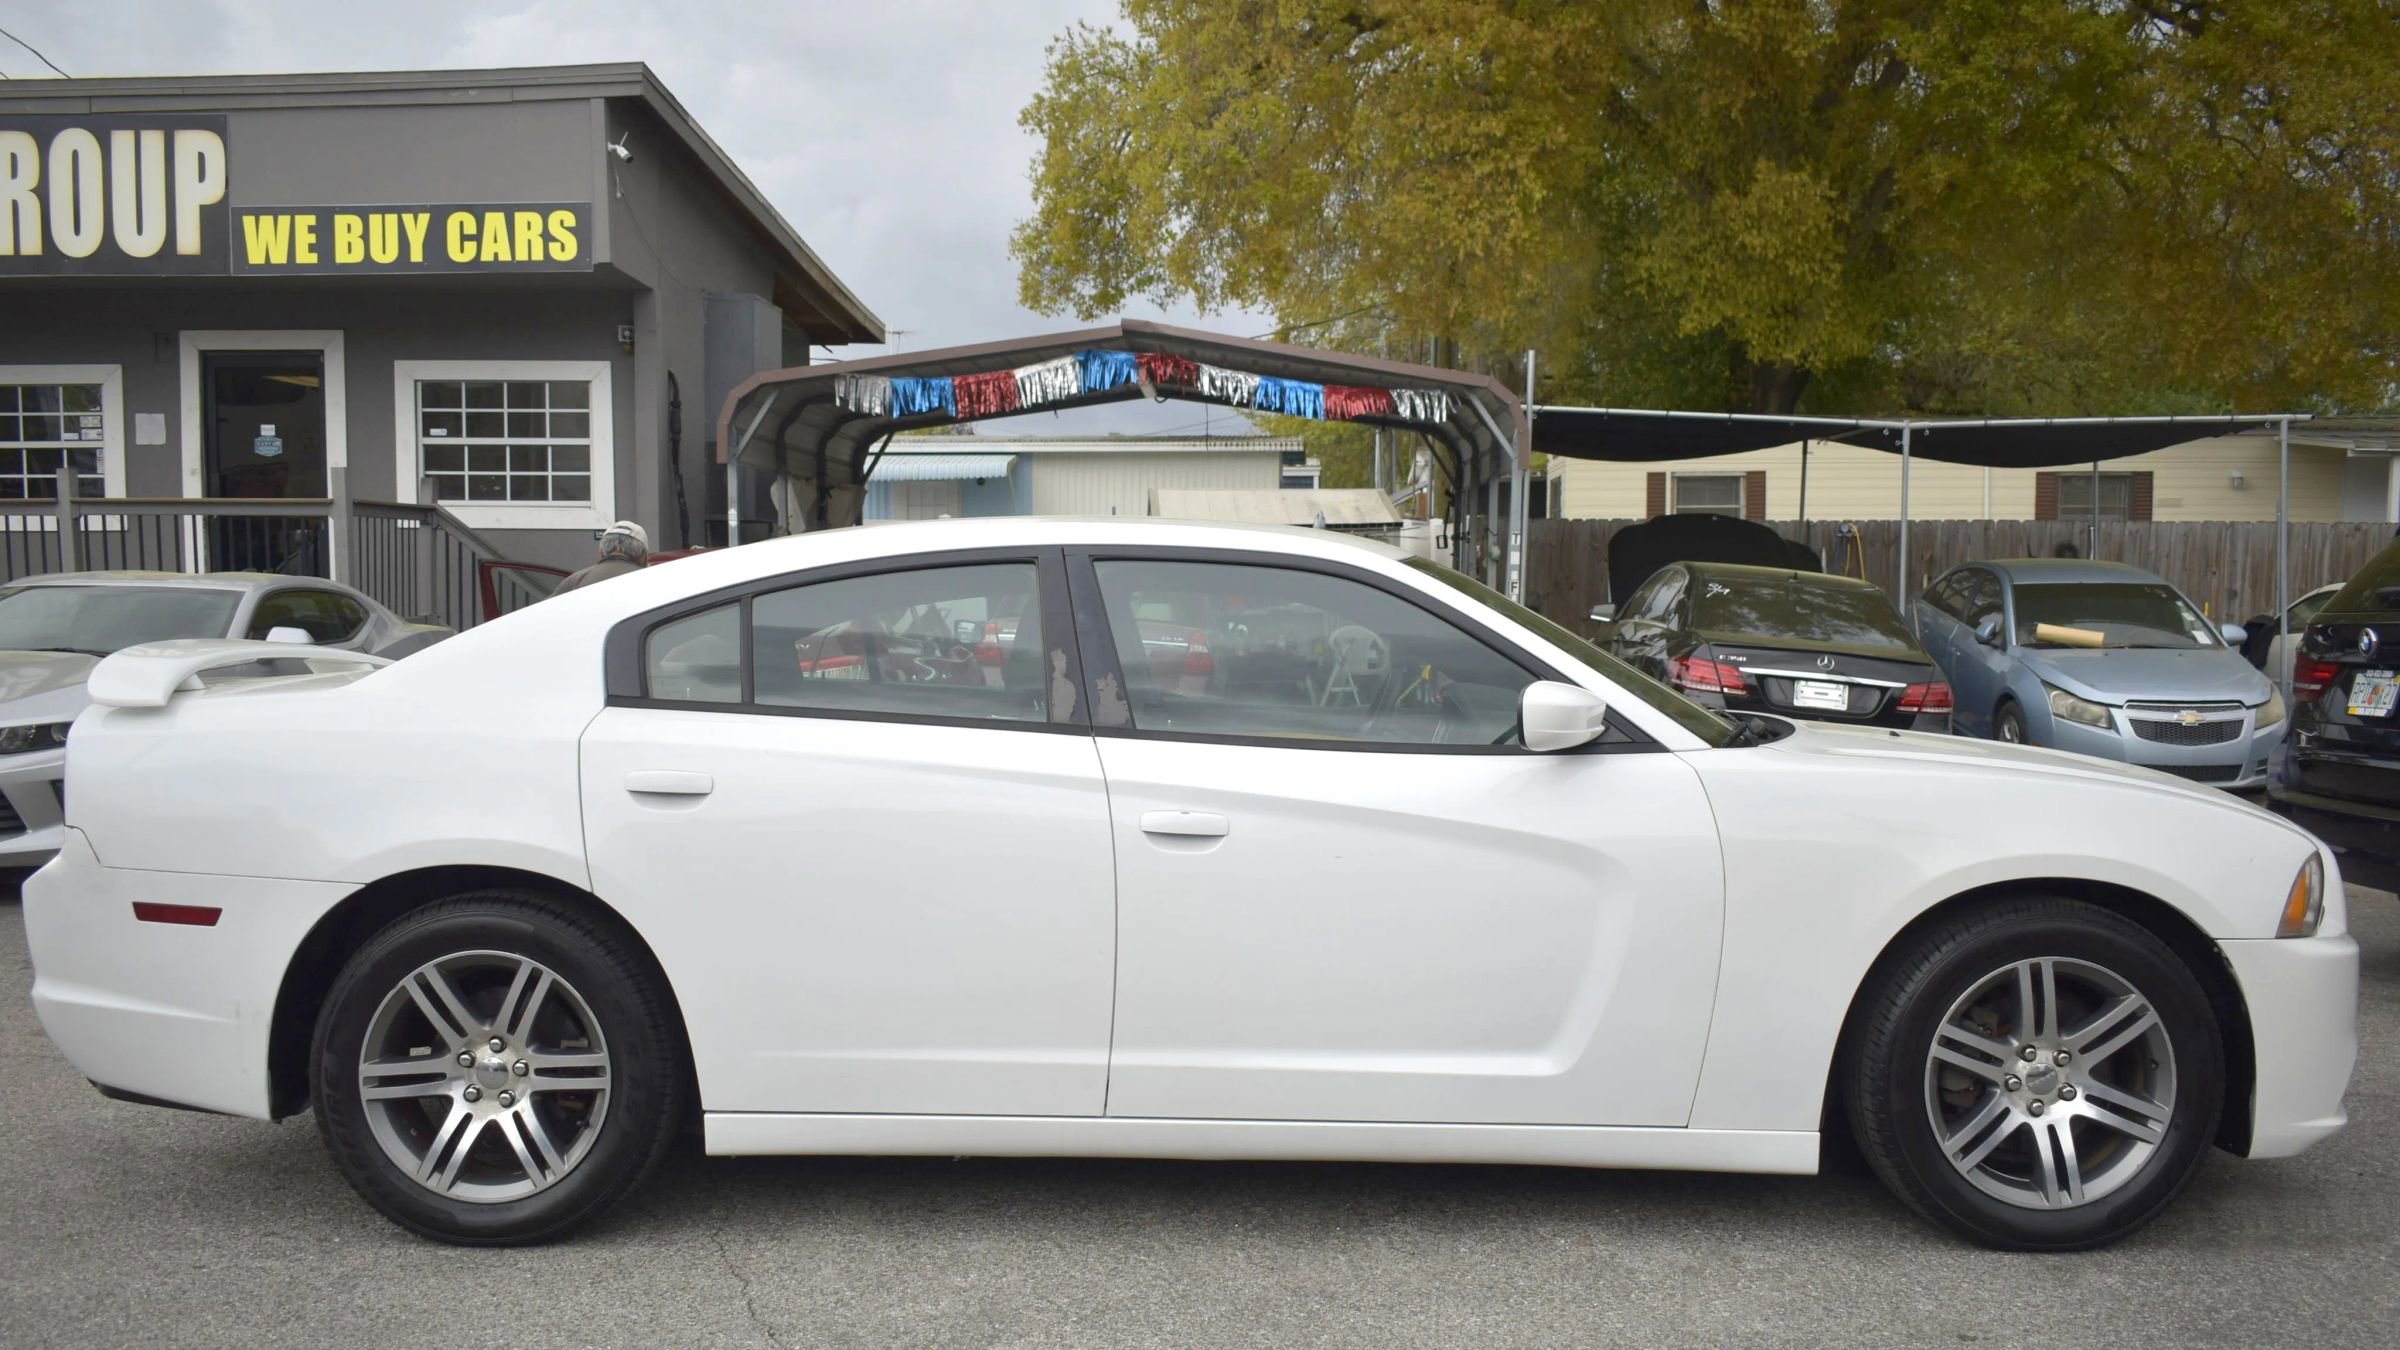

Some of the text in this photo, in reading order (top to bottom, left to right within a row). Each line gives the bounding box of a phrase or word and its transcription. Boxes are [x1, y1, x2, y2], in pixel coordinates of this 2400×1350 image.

[0, 128, 226, 258] ROUP
[242, 210, 578, 265] WE BUY CARS
